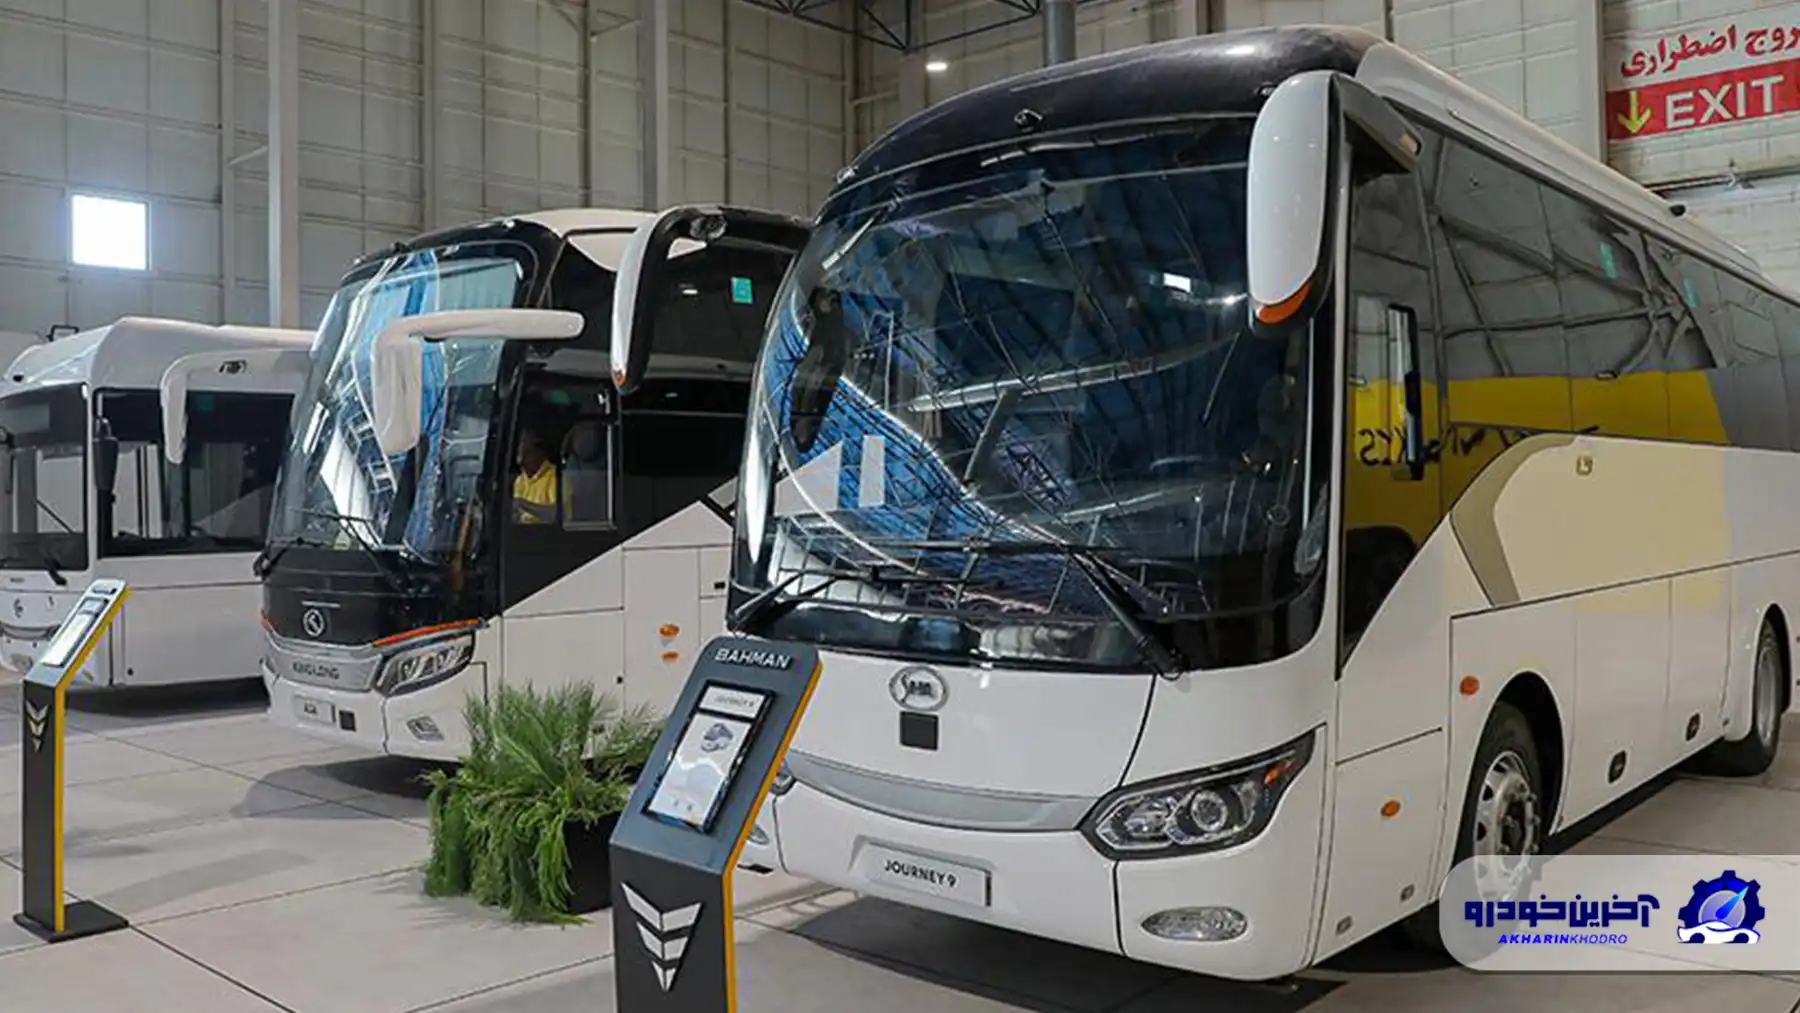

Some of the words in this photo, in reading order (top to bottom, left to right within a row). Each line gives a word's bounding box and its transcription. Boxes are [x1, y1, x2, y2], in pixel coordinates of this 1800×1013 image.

[1621, 24, 1737, 77] اضطراری
[1744, 26, 1800, 57] روج
[1666, 75, 1785, 129] EXIT
[714, 647, 791, 669] BAHMAN
[884, 859, 946, 886] JOURNEY
[946, 873, 957, 888] 9
